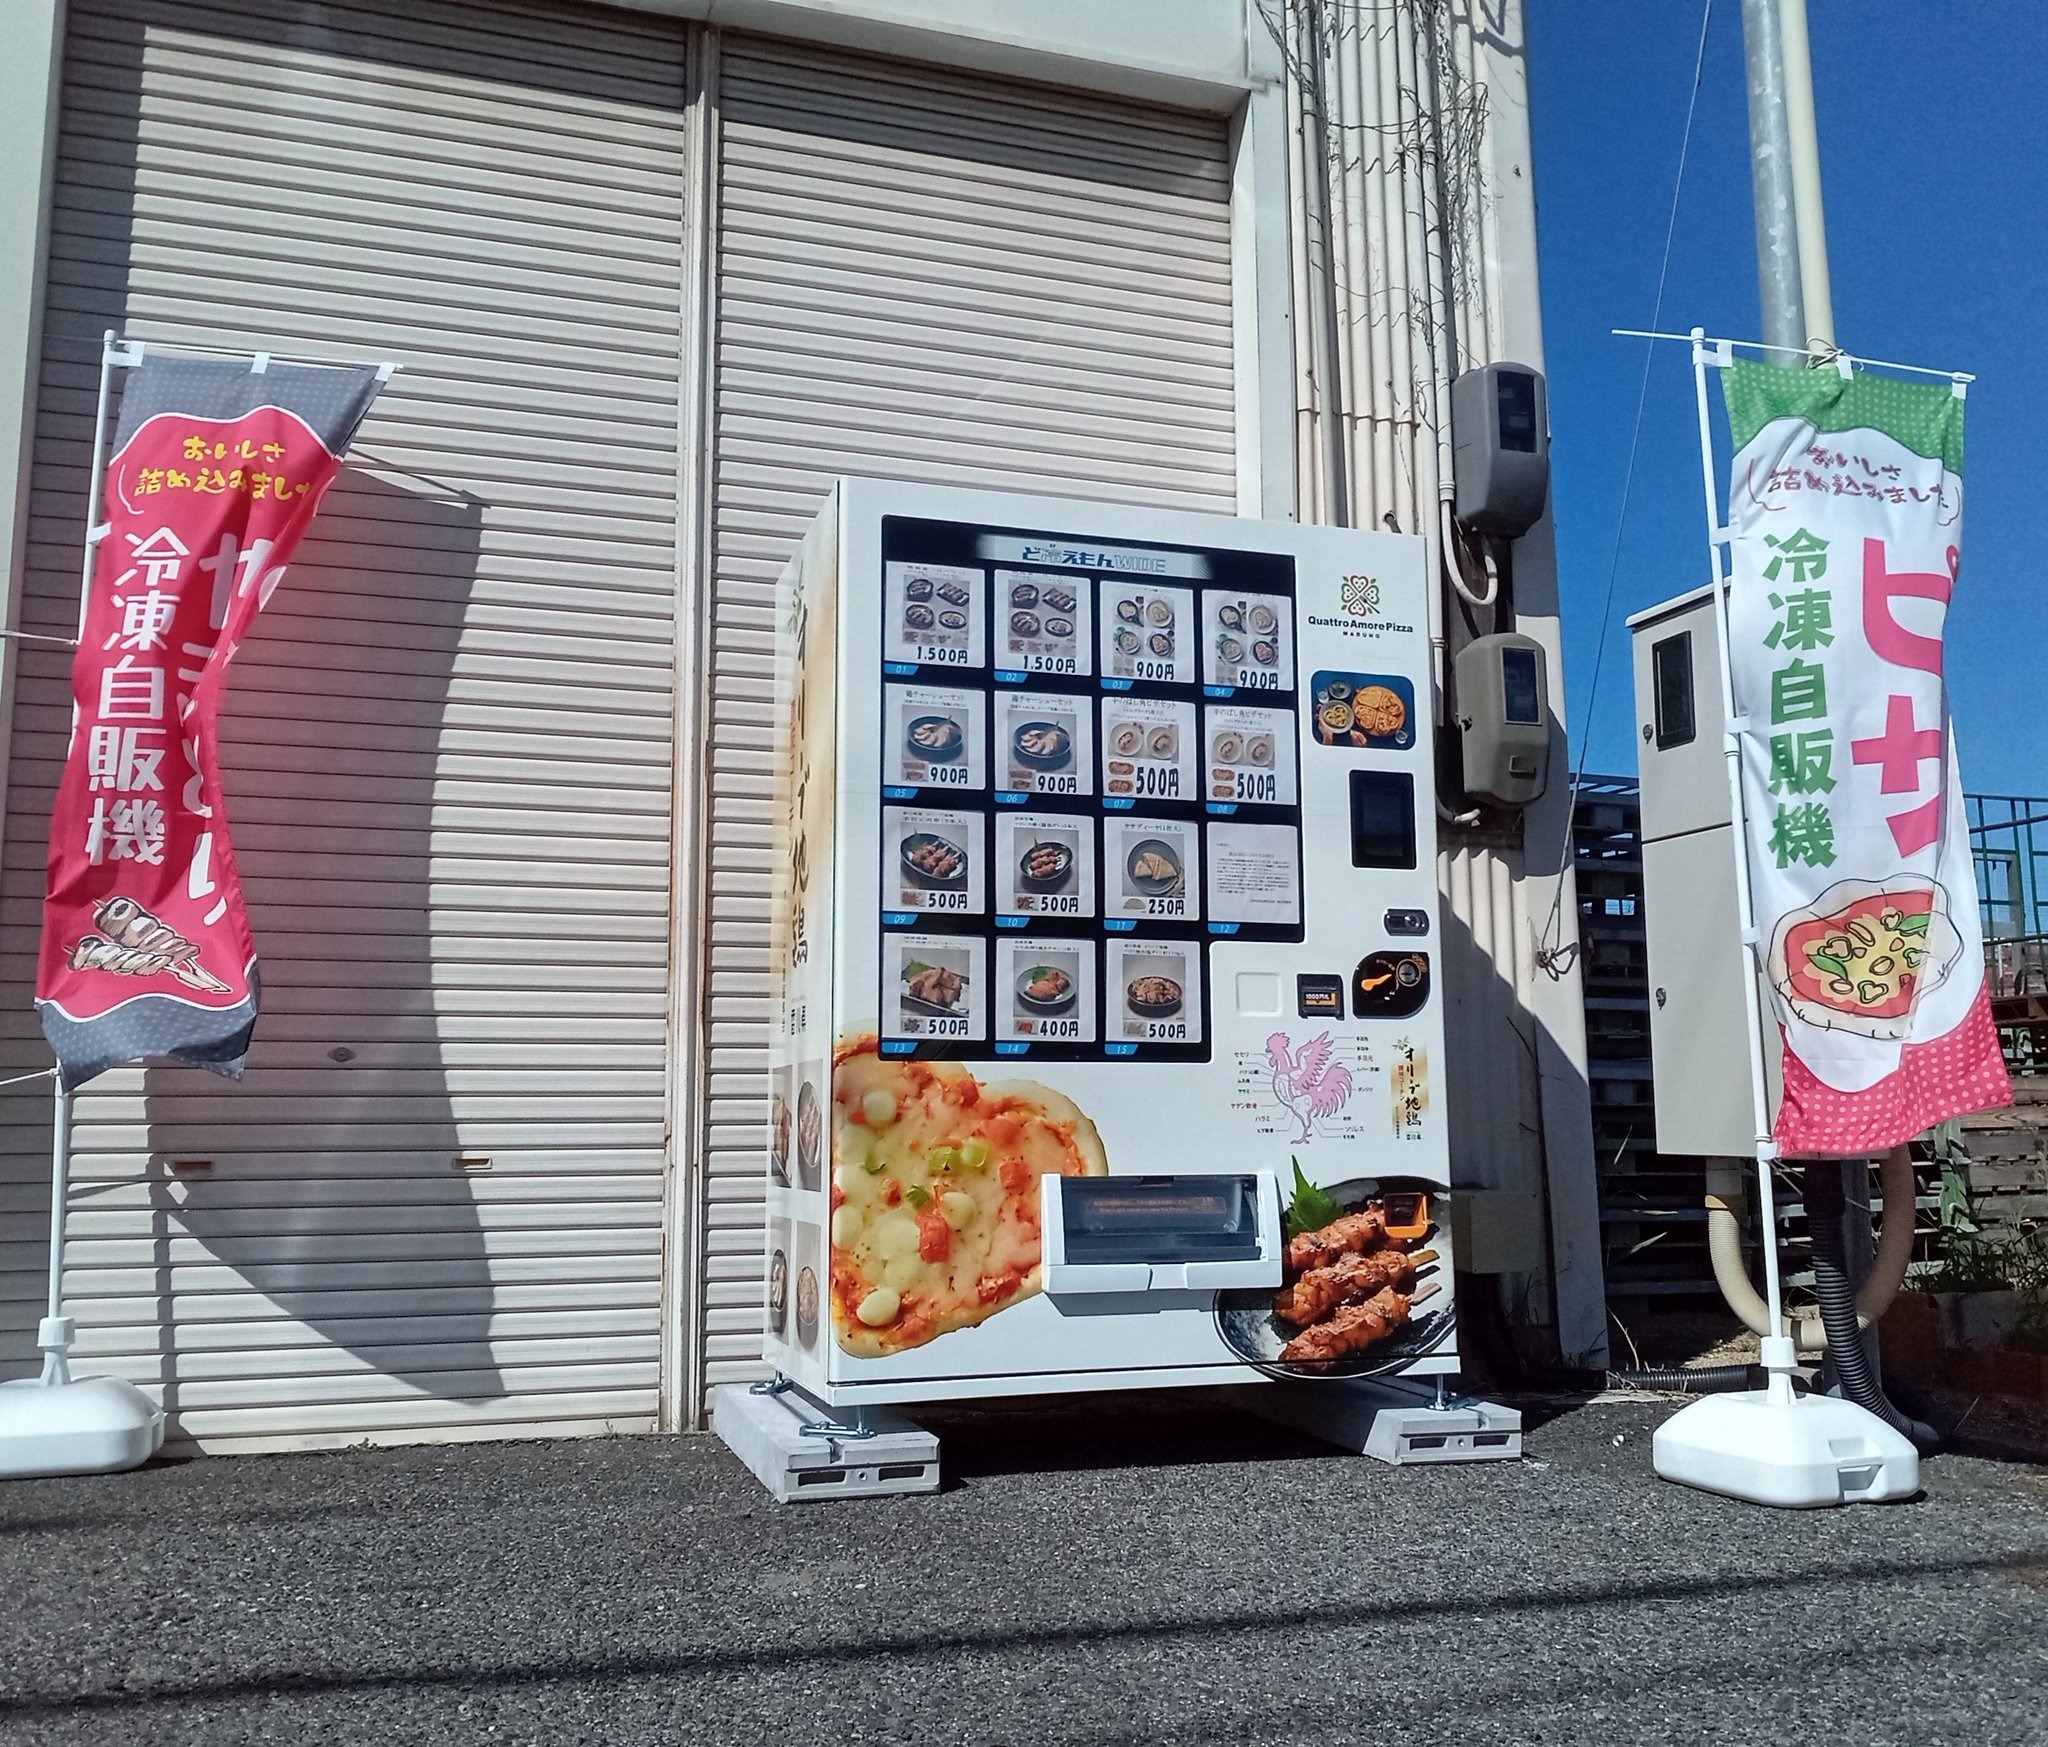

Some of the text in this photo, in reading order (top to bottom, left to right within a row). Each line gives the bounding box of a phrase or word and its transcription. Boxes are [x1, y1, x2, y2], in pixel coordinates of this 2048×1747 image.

[182, 435, 287, 464] おいしさ
[1805, 443, 1902, 482] おいしさ
[1308, 615, 1414, 633] Quattro Amore Pizza
[895, 665, 908, 674] 01
[1005, 672, 1018, 682] 02
[1136, 660, 1175, 681] 900円
[1239, 669, 1279, 690] 900円
[84, 526, 190, 867] 冷凍自販機
[1761, 526, 1838, 870] 冷凍自販機
[930, 766, 968, 784] 900円
[1038, 774, 1077, 794] 900円
[1136, 766, 1179, 798] 500円
[894, 788, 907, 798] 05
[1236, 772, 1276, 802] 500円
[1006, 794, 1018, 803] 06
[1114, 799, 1125, 808] 07
[928, 892, 968, 910] 500円
[1040, 893, 1079, 913] 500円
[1148, 898, 1184, 916] 250円
[894, 914, 906, 924] 09
[1007, 917, 1018, 927] 10
[928, 1019, 968, 1036] 500円
[1039, 1020, 1078, 1037] 400円
[1148, 1023, 1186, 1039] 500円
